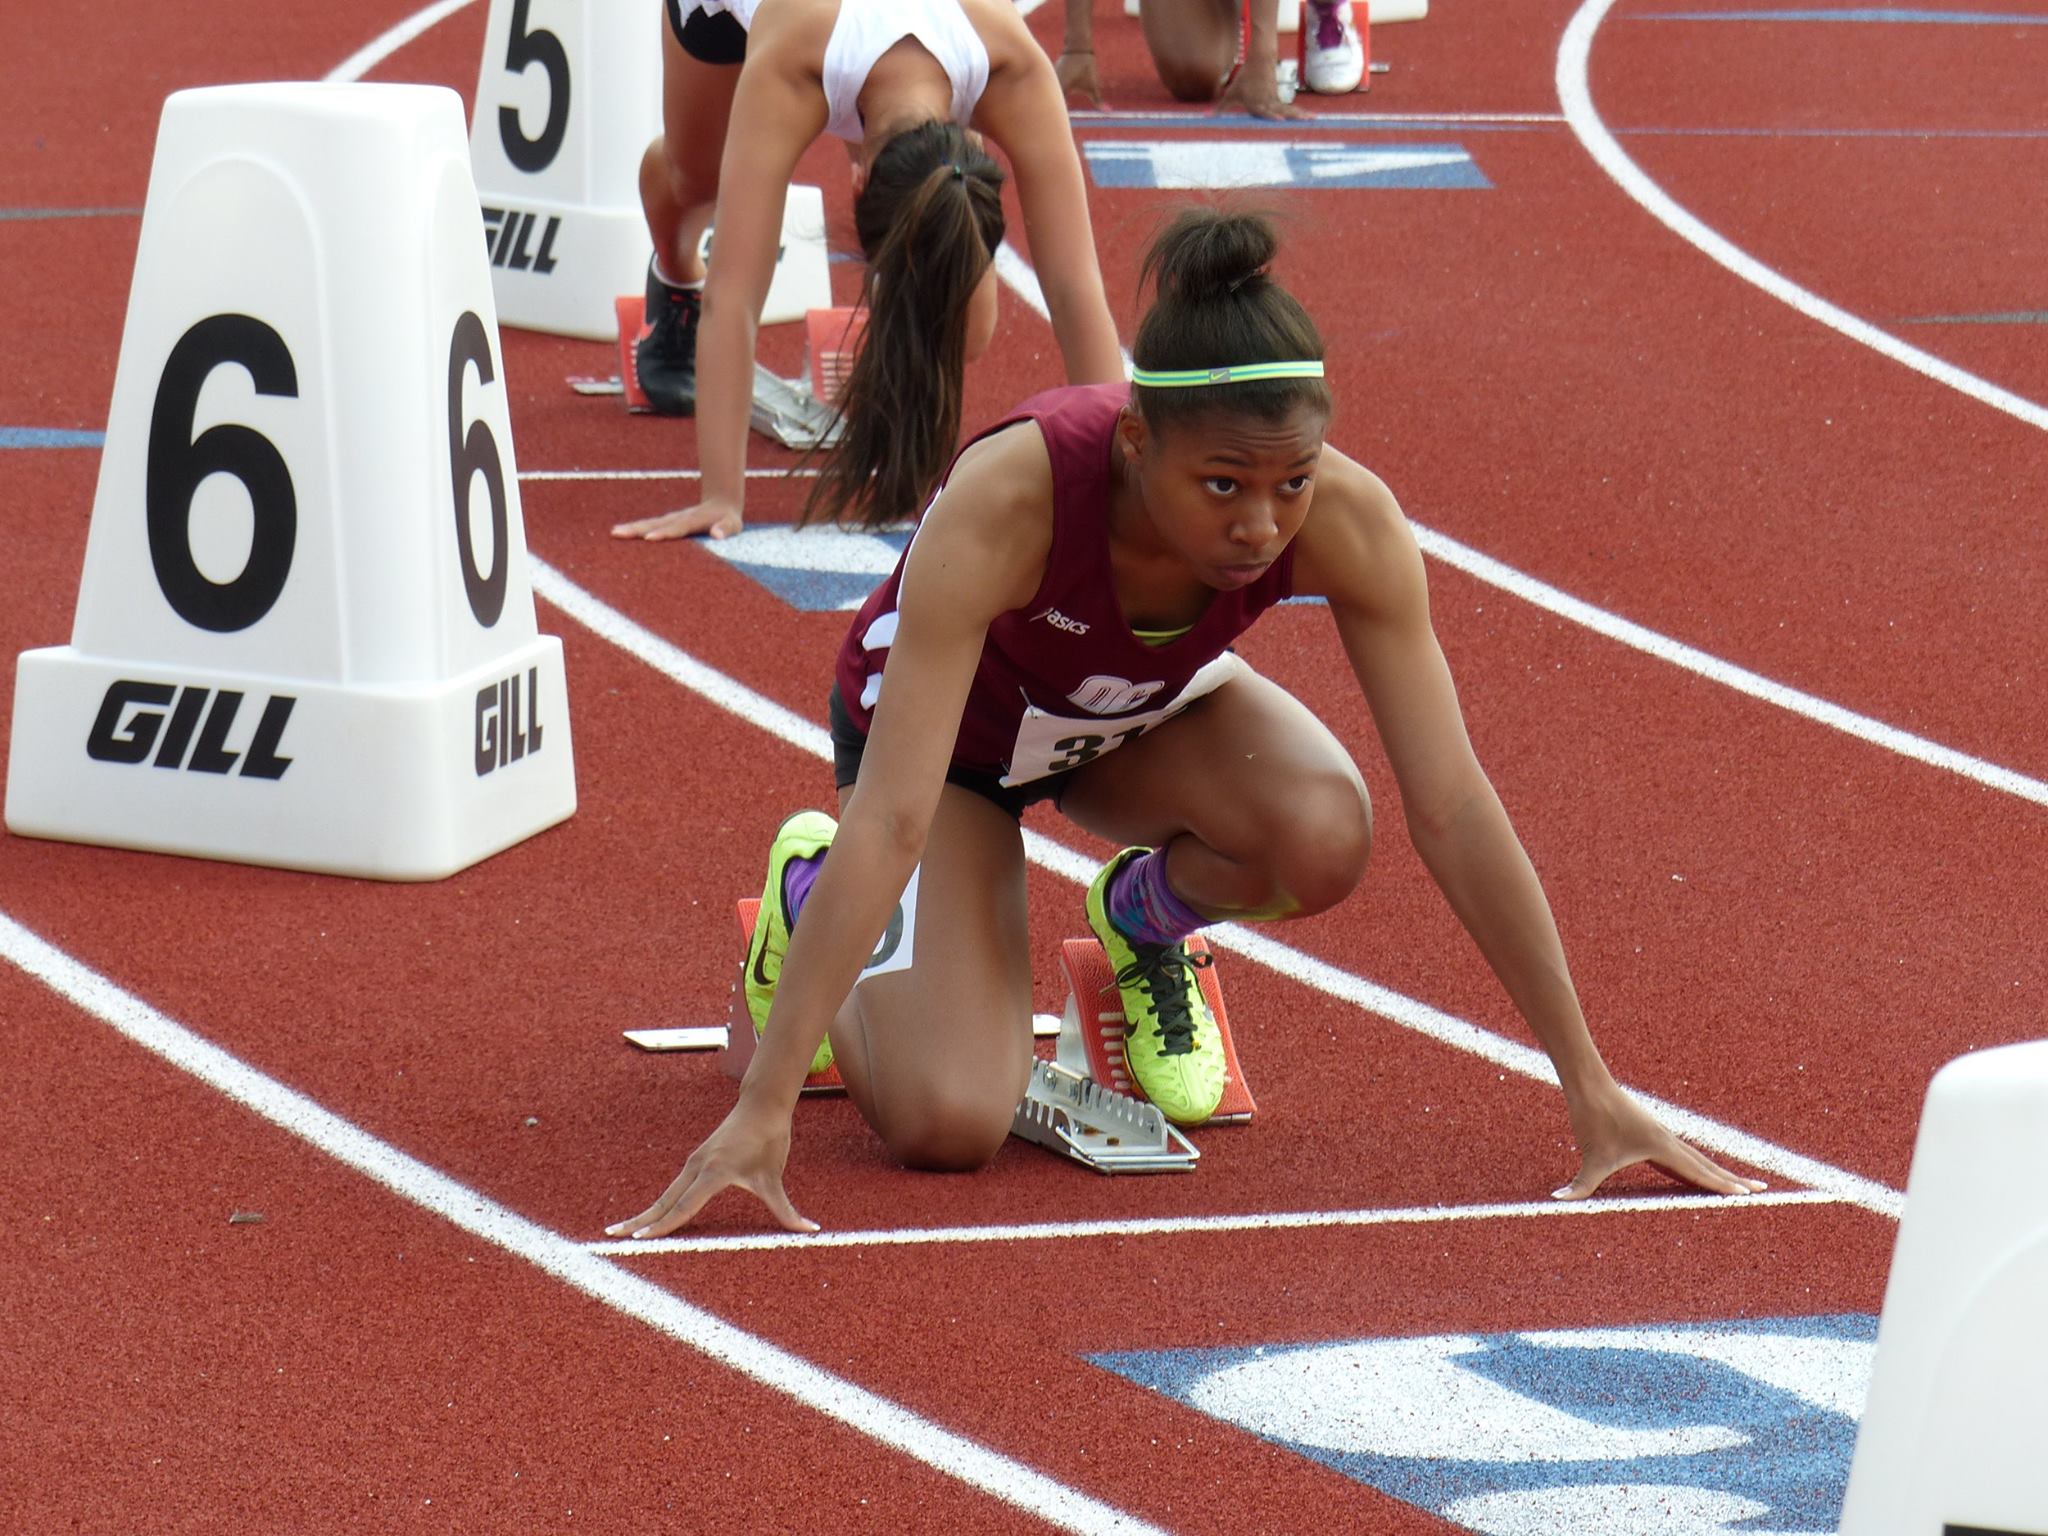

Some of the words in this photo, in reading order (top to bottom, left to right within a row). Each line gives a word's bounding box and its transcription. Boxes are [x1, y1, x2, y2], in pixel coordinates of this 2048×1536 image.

[498, 0, 570, 173] 5
[147, 313, 299, 633] 6
[448, 310, 508, 628] 6
[1046, 609, 1091, 636] asics
[87, 680, 297, 780] GILL
[475, 666, 543, 778] GILL
